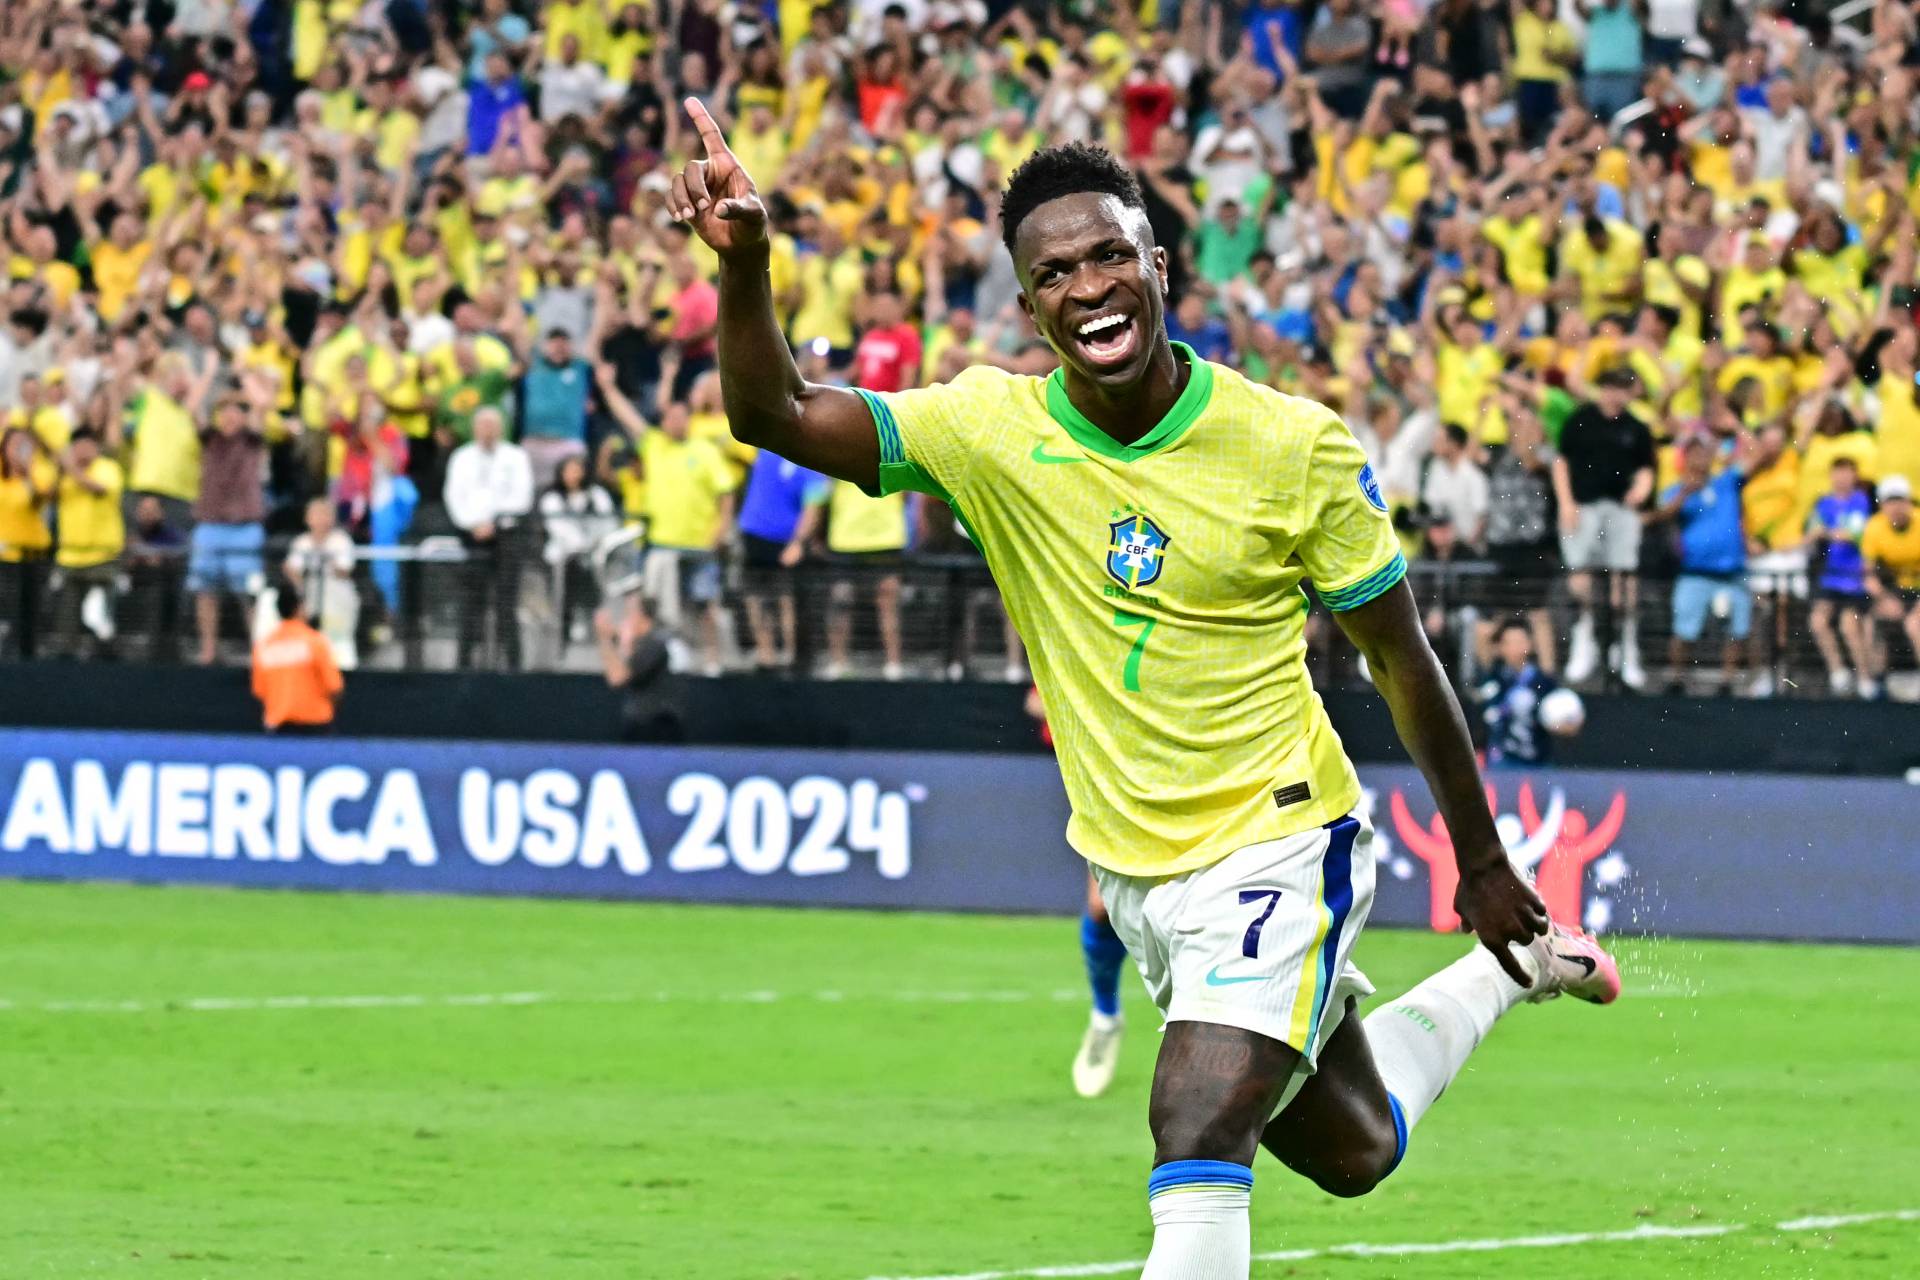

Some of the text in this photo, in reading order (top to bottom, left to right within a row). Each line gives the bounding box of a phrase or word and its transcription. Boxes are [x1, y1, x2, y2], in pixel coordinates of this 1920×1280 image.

[1125, 544, 1148, 556] CBF
[1113, 609, 1157, 692] 7
[1, 757, 911, 879] AMERICA USA 2024
[1239, 889, 1282, 959] 7
